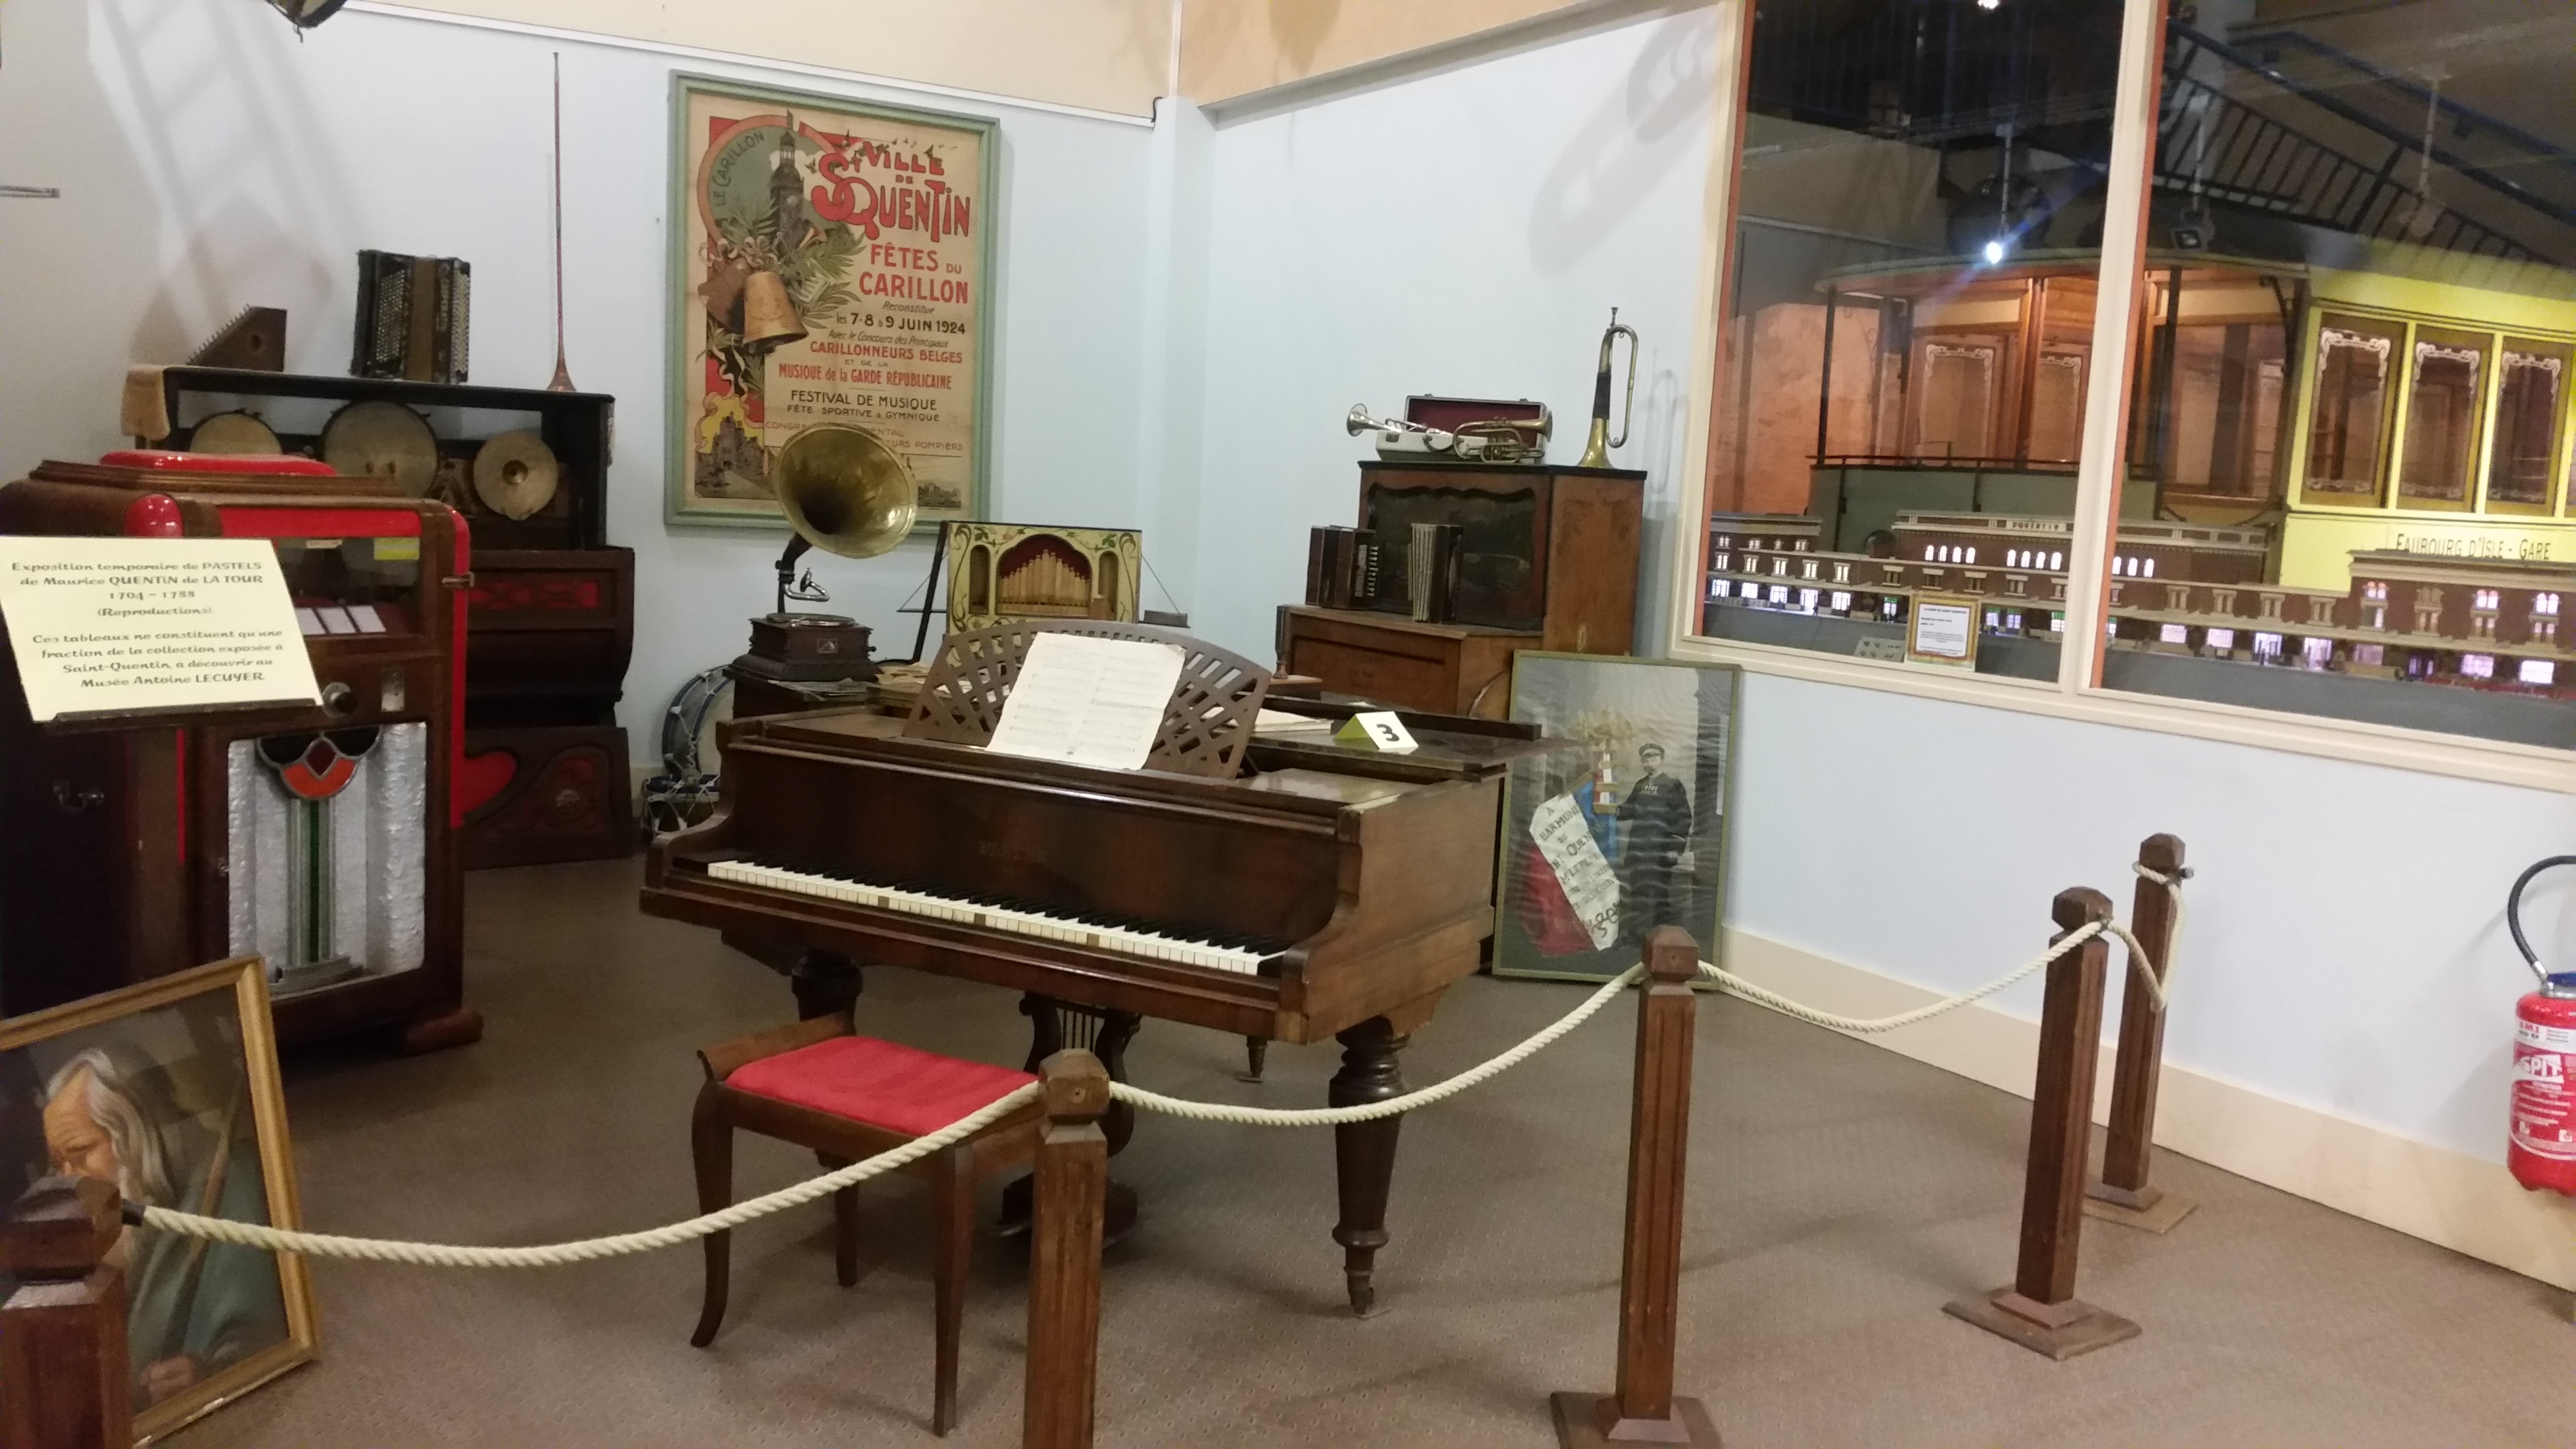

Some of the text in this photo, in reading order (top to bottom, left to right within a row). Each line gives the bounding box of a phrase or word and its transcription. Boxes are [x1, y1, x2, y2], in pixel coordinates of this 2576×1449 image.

[712, 131, 765, 187] CARILLON
[862, 141, 945, 176] VILLE
[870, 242, 962, 274] FÊTES DU
[859, 272, 968, 304] CARILLON
[836, 312, 847, 324] les
[886, 316, 895, 328] 9
[898, 318, 932, 332] JUIN
[936, 320, 966, 335] 1924
[827, 329, 846, 340] Avec
[858, 331, 893, 344] Concours
[895, 336, 907, 345] des
[810, 341, 963, 364] CARILLONNEURS BELGES
[779, 363, 952, 390] MUSIQUE de la GARDE RÉPUBLICAINE
[791, 390, 937, 411] FESTIVAL DE MUSIQUE
[821, 407, 872, 418] SPORTIVE
[886, 412, 940, 422] GYMNIQUE
[2519, 538, 2552, 561] GARE
[12, 562, 94, 573] Exposition
[202, 562, 263, 570] PASTELS
[20, 577, 39, 585] de
[43, 577, 105, 585] Maurice
[203, 575, 221, 584] LA
[224, 575, 264, 584] TOUR
[109, 591, 144, 601] 1704
[162, 590, 196, 599] 1788
[32, 634, 59, 644] Ces
[63, 633, 130, 643] tableaux
[155, 631, 234, 640] constituent
[41, 649, 103, 659] fraction
[107, 647, 125, 656] de
[128, 646, 143, 655] la
[146, 645, 216, 655] collection
[218, 644, 272, 654] exposée
[187, 659, 254, 668] découvrir
[80, 678, 129, 688] Musée
[133, 675, 192, 684] Antoine
[1376, 724, 1400, 742] 3
